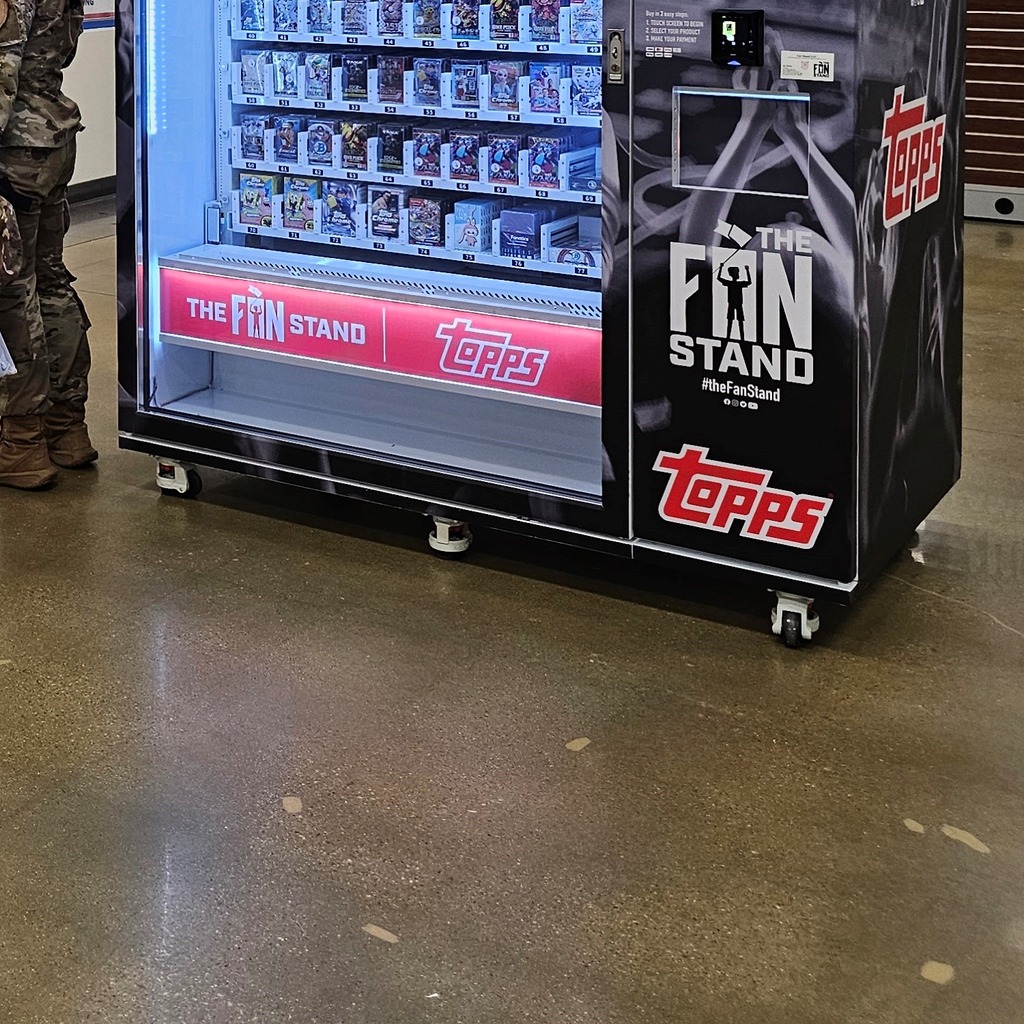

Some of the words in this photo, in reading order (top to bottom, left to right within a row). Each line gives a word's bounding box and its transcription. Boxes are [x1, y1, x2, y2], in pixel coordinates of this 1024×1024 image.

[373, 215, 398, 224] Chrome
[756, 226, 813, 254] THE
[186, 297, 227, 324] THE
[290, 314, 366, 345] STAND
[669, 334, 814, 385] STAND
[701, 377, 780, 403] #theFanStand
